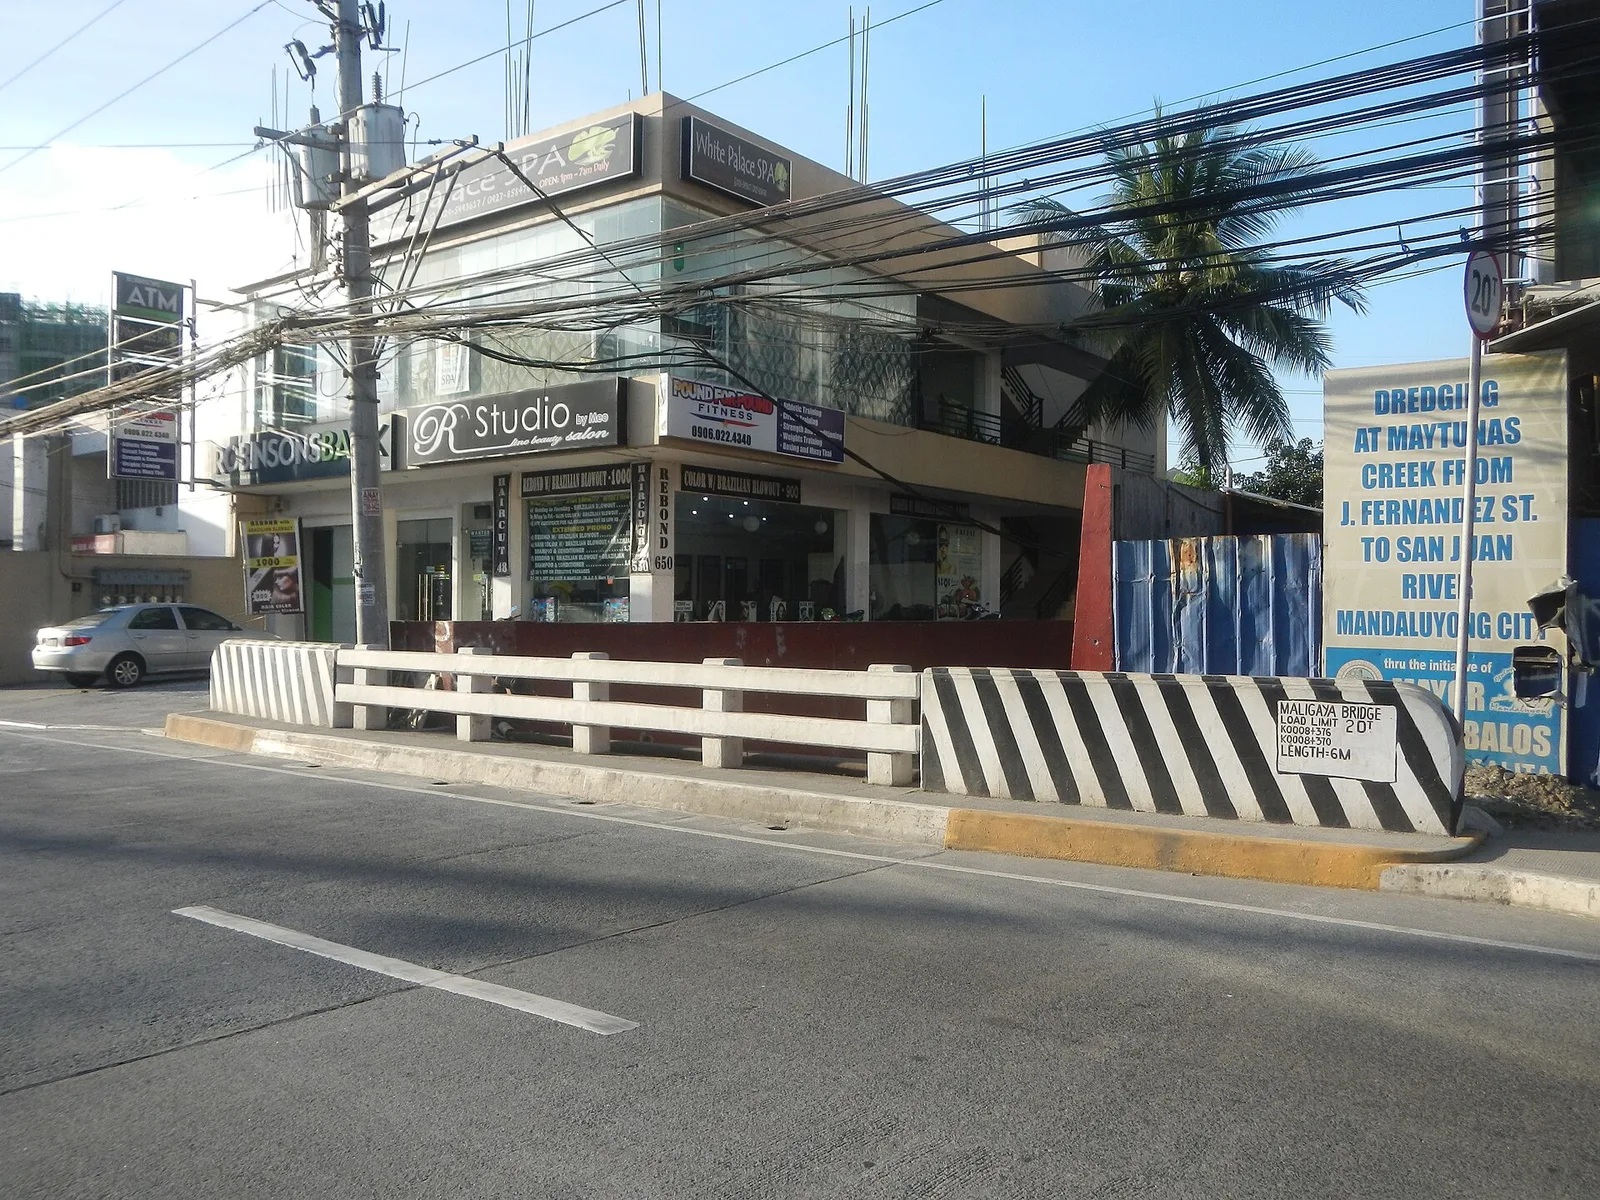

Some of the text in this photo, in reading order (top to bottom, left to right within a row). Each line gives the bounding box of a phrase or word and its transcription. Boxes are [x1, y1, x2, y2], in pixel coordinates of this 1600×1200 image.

[696, 131, 775, 184] White Palace SPA
[126, 285, 177, 312] ATM
[672, 377, 774, 415] POUND FOR POUND
[1374, 380, 1499, 415] DREDGIG
[474, 396, 570, 437] Studio
[575, 413, 588, 426] by
[698, 403, 753, 421] FITNESS
[565, 426, 609, 441] salon
[691, 425, 751, 446] 0906.022.4340
[1354, 427, 1382, 453] AT
[215, 424, 390, 475] ROBINSONSBAK
[522, 475, 544, 493] REBOND
[551, 473, 580, 490] BRAZILIAN
[580, 470, 607, 488] BLOWOUT
[684, 470, 706, 488] COLOR
[717, 473, 751, 493] BRAZILIAN
[752, 479, 781, 497] BLOWOUT
[1361, 460, 1436, 489] CREEK
[498, 477, 506, 555] HAIRCUT
[659, 467, 669, 549] REBOND
[1341, 501, 1356, 526] J.
[1501, 494, 1538, 523] ST.
[552, 524, 612, 534] EXTENDED PROMO
[1360, 536, 1390, 562] TO
[1396, 536, 1444, 562] SAN
[256, 558, 280, 567] 1000
[496, 561, 508, 573] 48
[655, 555, 673, 570] 650
[1384, 658, 1493, 674] thru the initiave of
[1280, 702, 1382, 720] MALIGAYA BRIDGE
[1280, 716, 1307, 726] LOAD
[1311, 717, 1339, 728] LIMIT
[1280, 744, 1351, 760] LENGTH=6M
